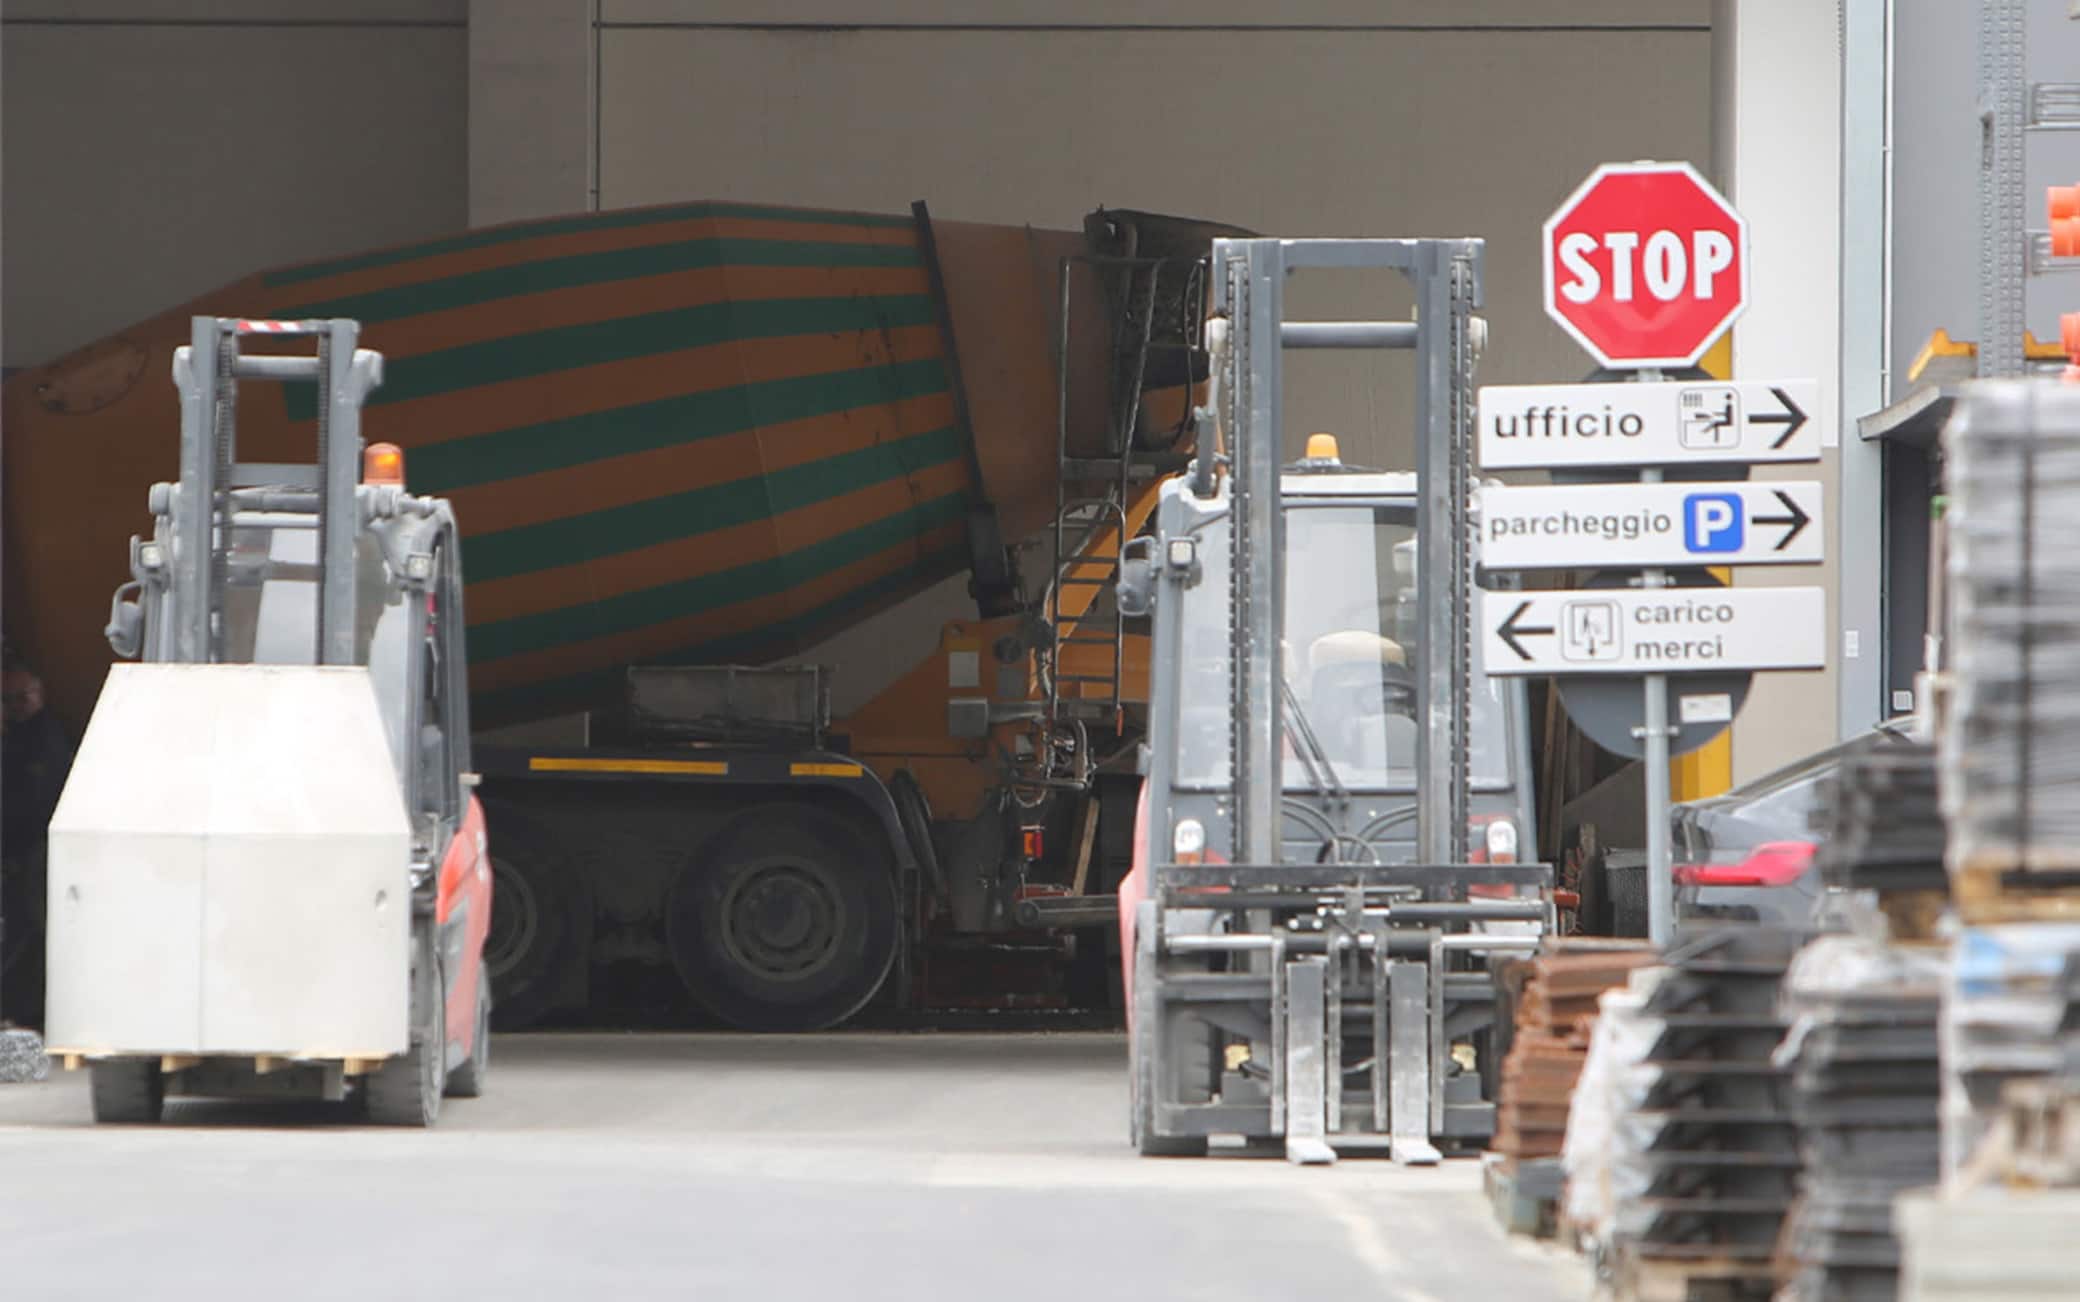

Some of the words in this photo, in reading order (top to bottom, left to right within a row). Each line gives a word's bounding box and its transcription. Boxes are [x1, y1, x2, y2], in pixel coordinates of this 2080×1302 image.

[1559, 230, 1734, 304] STOP
[1494, 406, 1643, 437] ufficio
[1490, 510, 1672, 541] parcheggio
[1695, 499, 1734, 547] P
[1634, 599, 1735, 626] carico
[1634, 636, 1724, 660] merci
